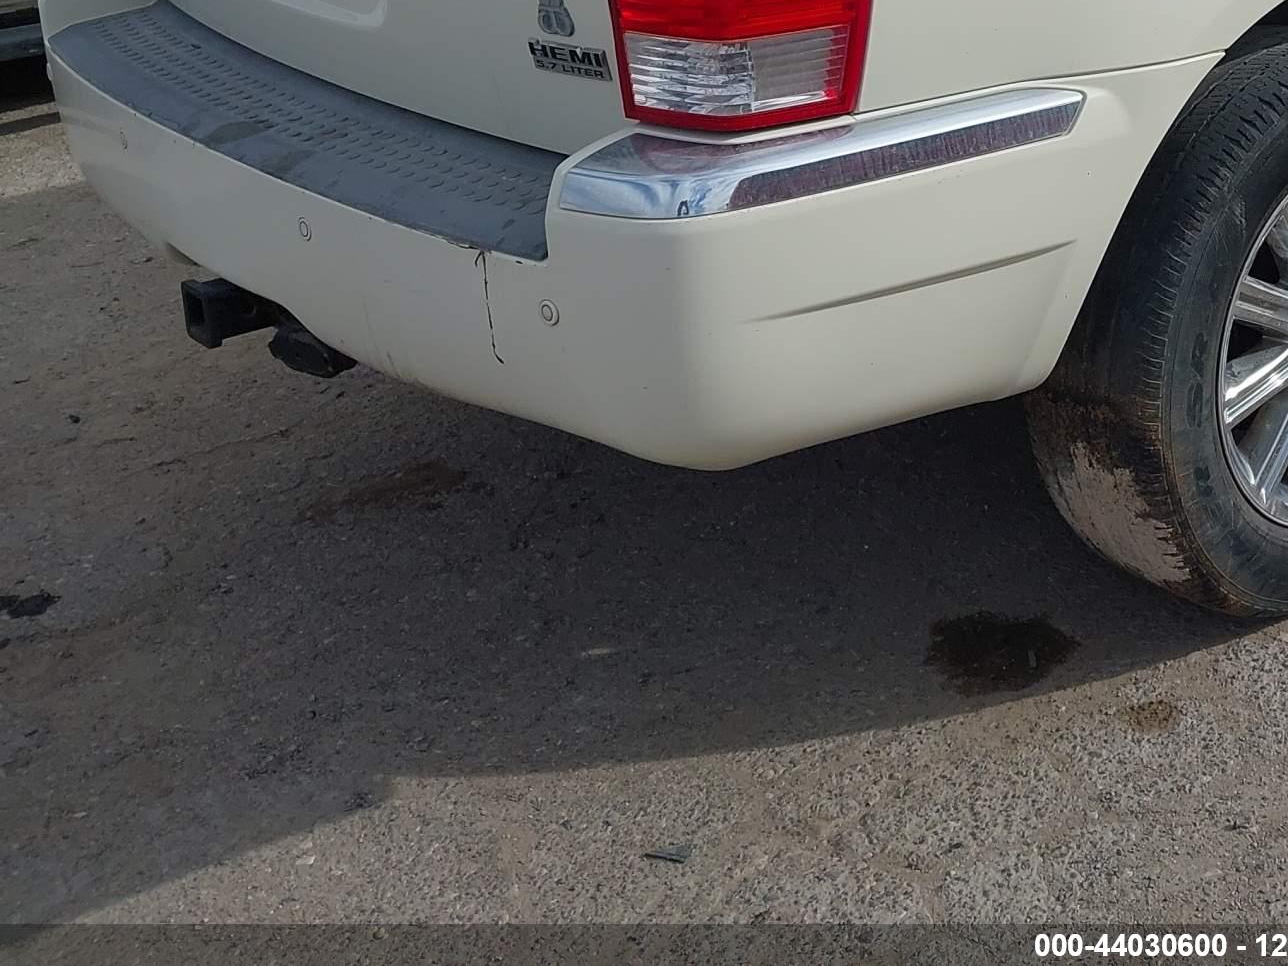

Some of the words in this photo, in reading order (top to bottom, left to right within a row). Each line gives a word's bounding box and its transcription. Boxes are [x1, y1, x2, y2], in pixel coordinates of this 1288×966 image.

[527, 39, 604, 68] HEMI
[535, 59, 557, 70] 5.7
[561, 64, 605, 80] LITER
